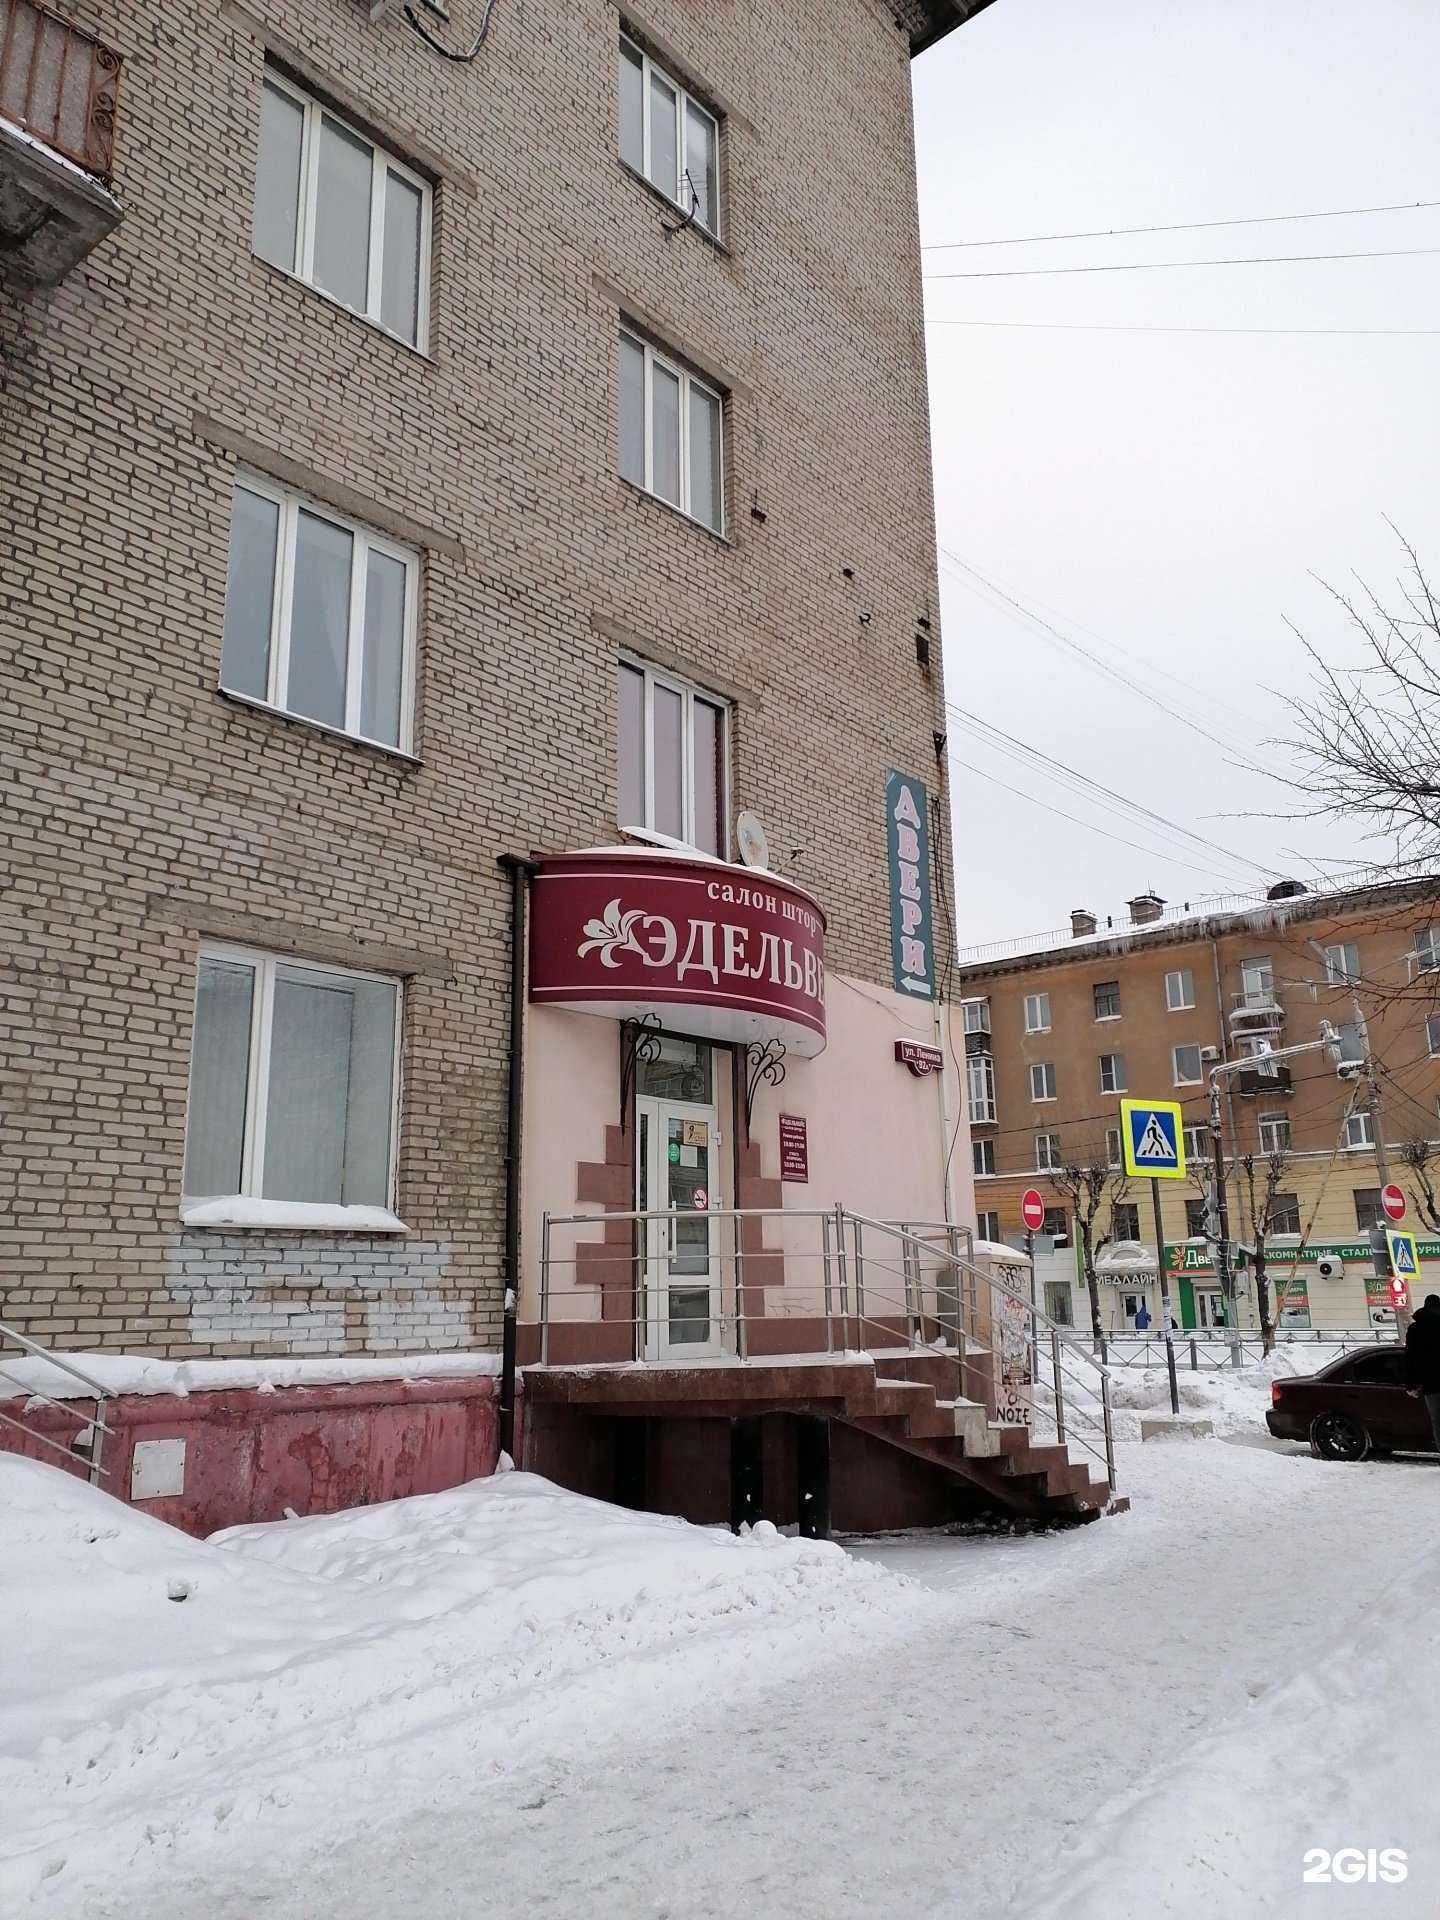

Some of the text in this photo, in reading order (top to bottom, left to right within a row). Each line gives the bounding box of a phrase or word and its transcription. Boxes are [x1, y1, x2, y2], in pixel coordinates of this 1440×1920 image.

[707, 881, 817, 937] салон штор
[905, 1047, 941, 1062] ул. Ленина
